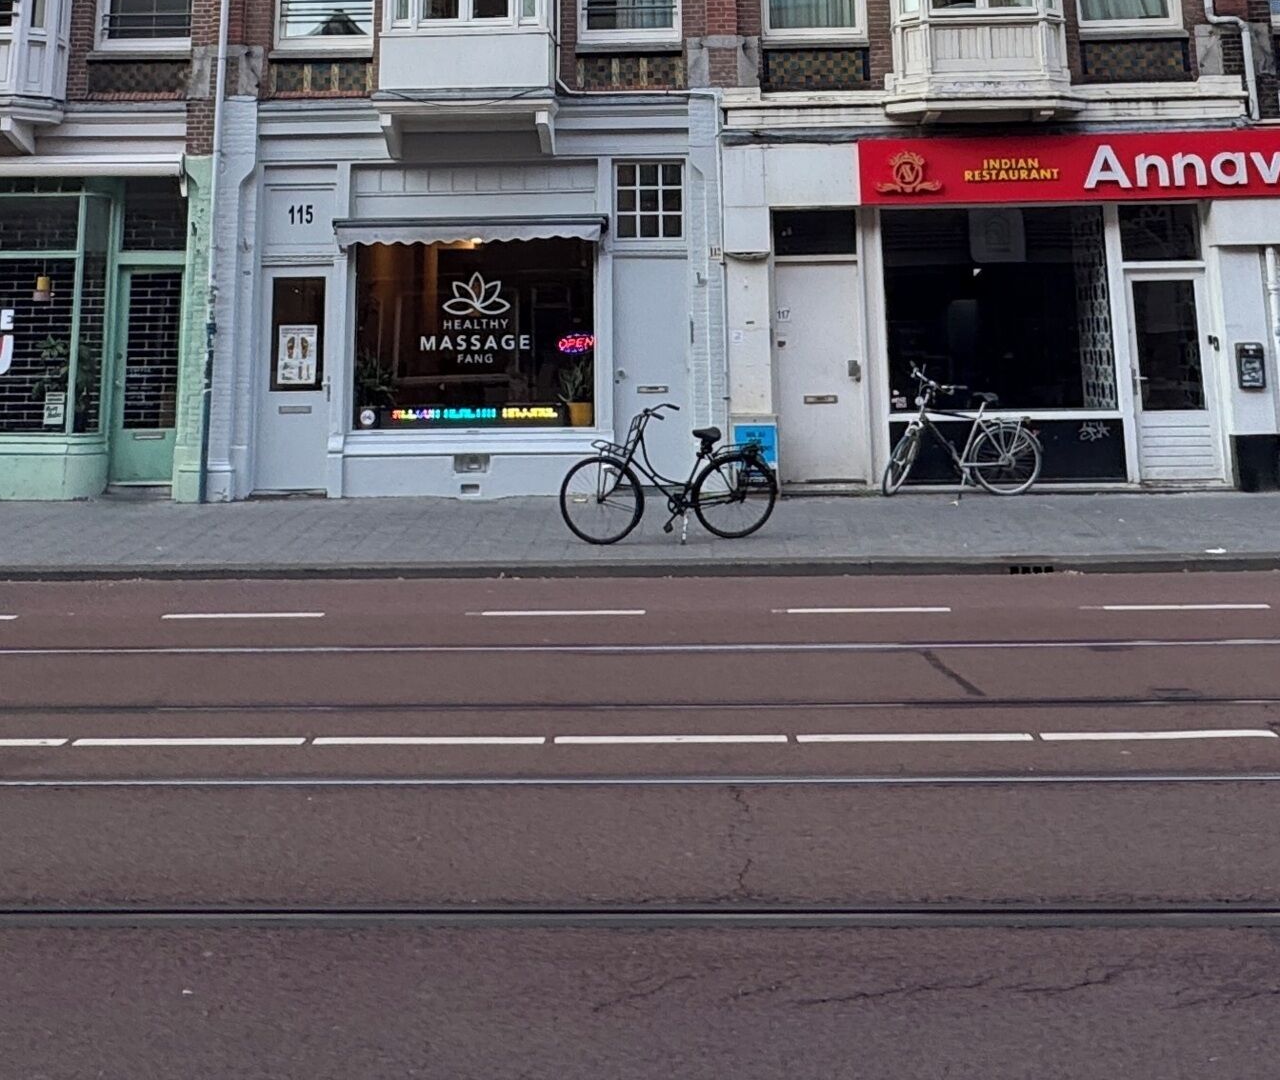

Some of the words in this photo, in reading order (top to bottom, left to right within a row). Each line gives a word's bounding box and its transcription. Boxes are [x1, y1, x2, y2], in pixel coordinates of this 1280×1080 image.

[983, 158, 1039, 169] INDIAN
[964, 168, 1059, 181] RESTAURANT
[288, 204, 314, 225] 115
[777, 310, 790, 319] 117
[443, 318, 509, 330] HEALTHY
[420, 334, 531, 351] MASSAGE
[558, 335, 596, 351] OPEN
[457, 353, 494, 364] FANG
